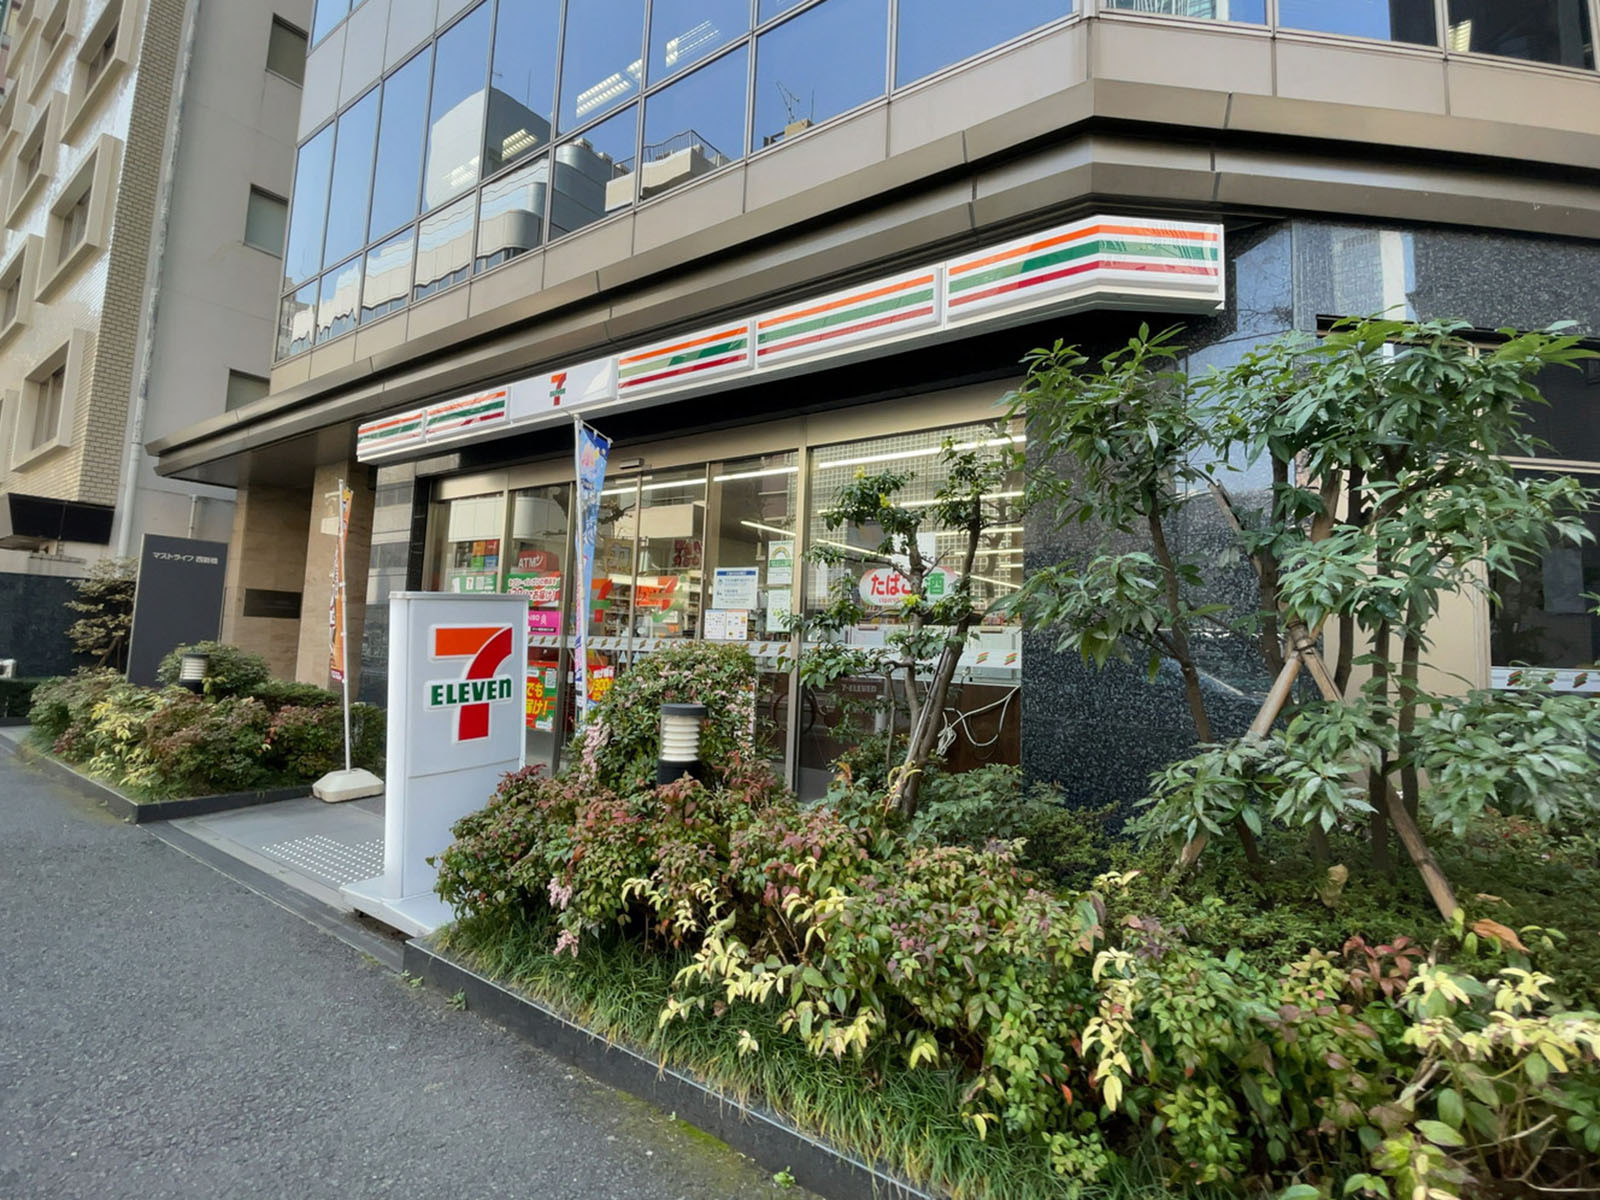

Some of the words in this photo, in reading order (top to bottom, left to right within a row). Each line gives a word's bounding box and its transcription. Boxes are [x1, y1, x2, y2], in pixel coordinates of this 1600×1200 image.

[551, 371, 567, 406] 7
[518, 557, 537, 569] ATM
[925, 572, 945, 595] 酒
[434, 626, 513, 741] 7
